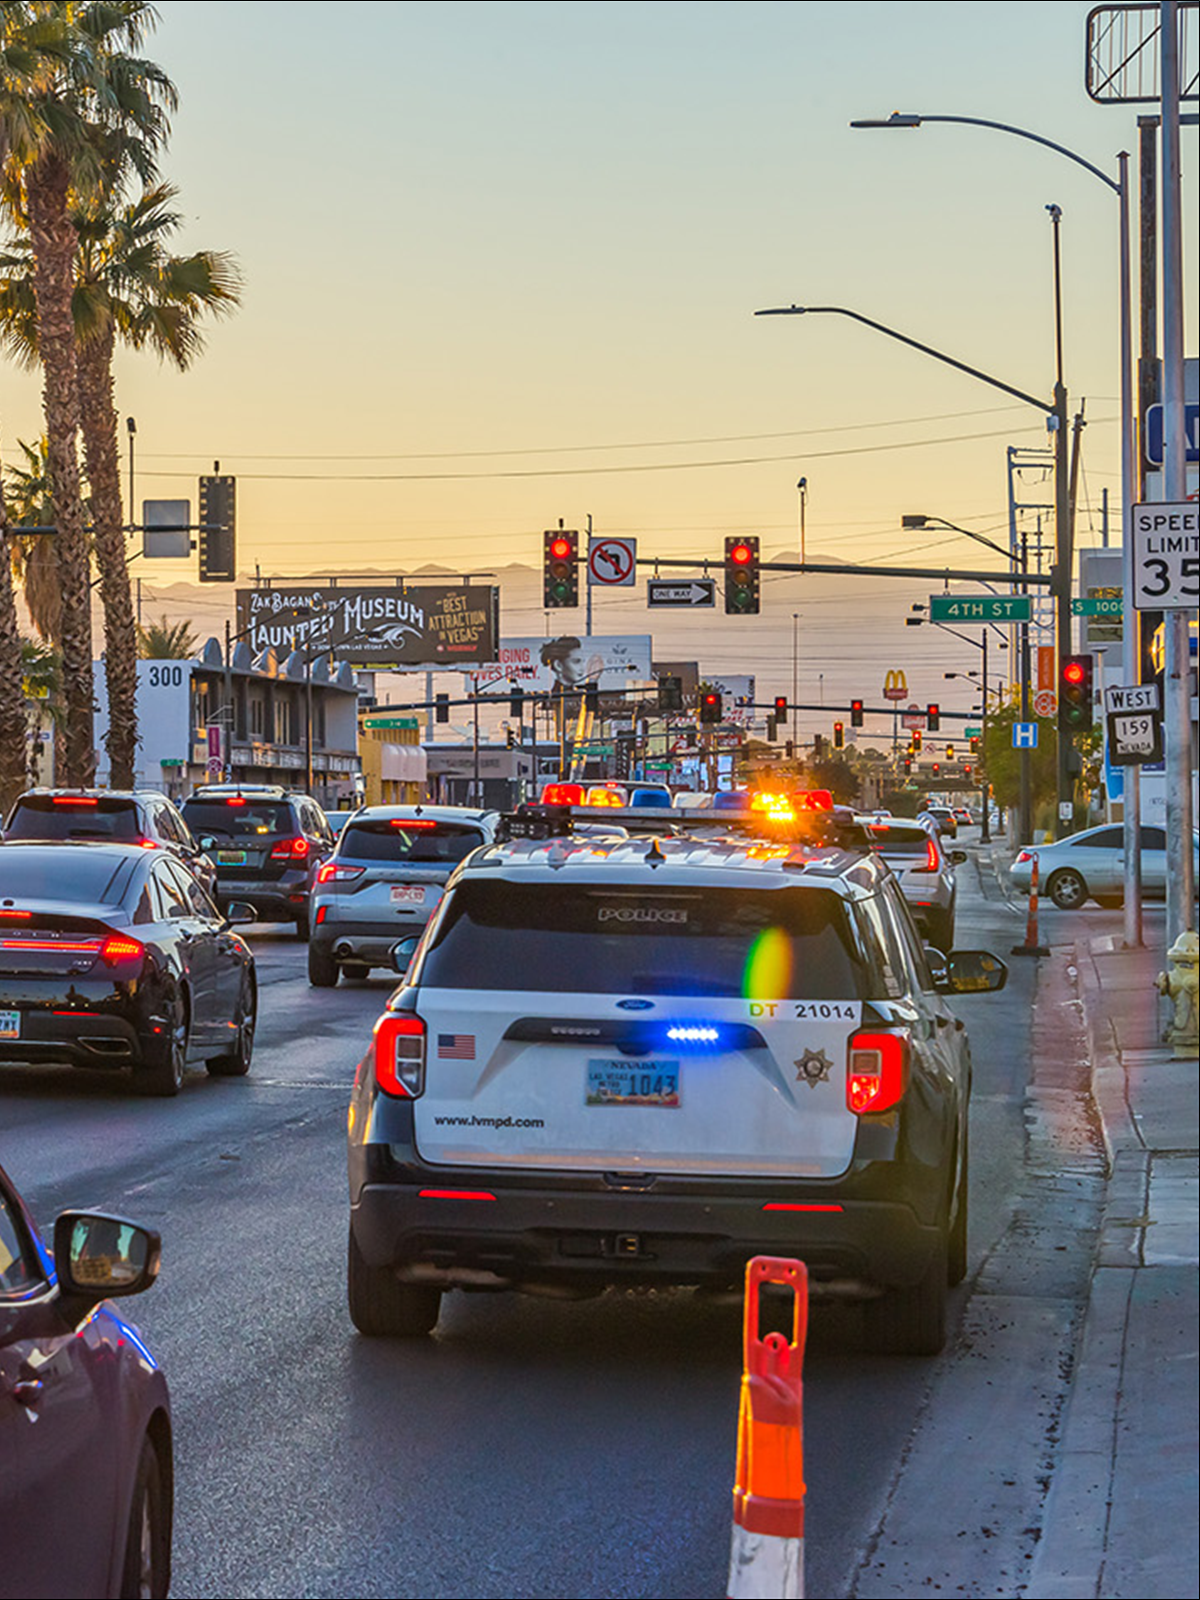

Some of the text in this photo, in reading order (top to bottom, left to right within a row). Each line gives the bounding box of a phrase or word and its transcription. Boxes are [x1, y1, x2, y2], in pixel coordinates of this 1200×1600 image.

[1140, 514, 1199, 531] SPEE
[1141, 558, 1199, 597] 35
[653, 590, 670, 598] ONE
[344, 595, 424, 634] MUSEUM
[948, 602, 1013, 616] 4TH ST
[1075, 601, 1084, 612] S
[429, 610, 487, 631] ATTRACTION
[149, 665, 183, 687] 300
[1110, 690, 1153, 708] WEST
[1015, 725, 1034, 747] H
[1121, 720, 1150, 736] 159
[1119, 742, 1152, 752] NEVADA
[598, 907, 687, 923] POLICE
[749, 1002, 855, 1020] DT 21014
[610, 1061, 657, 1070] NEVADA
[628, 1074, 676, 1097] 1043
[434, 1114, 545, 1130] www.lvmpd.com
